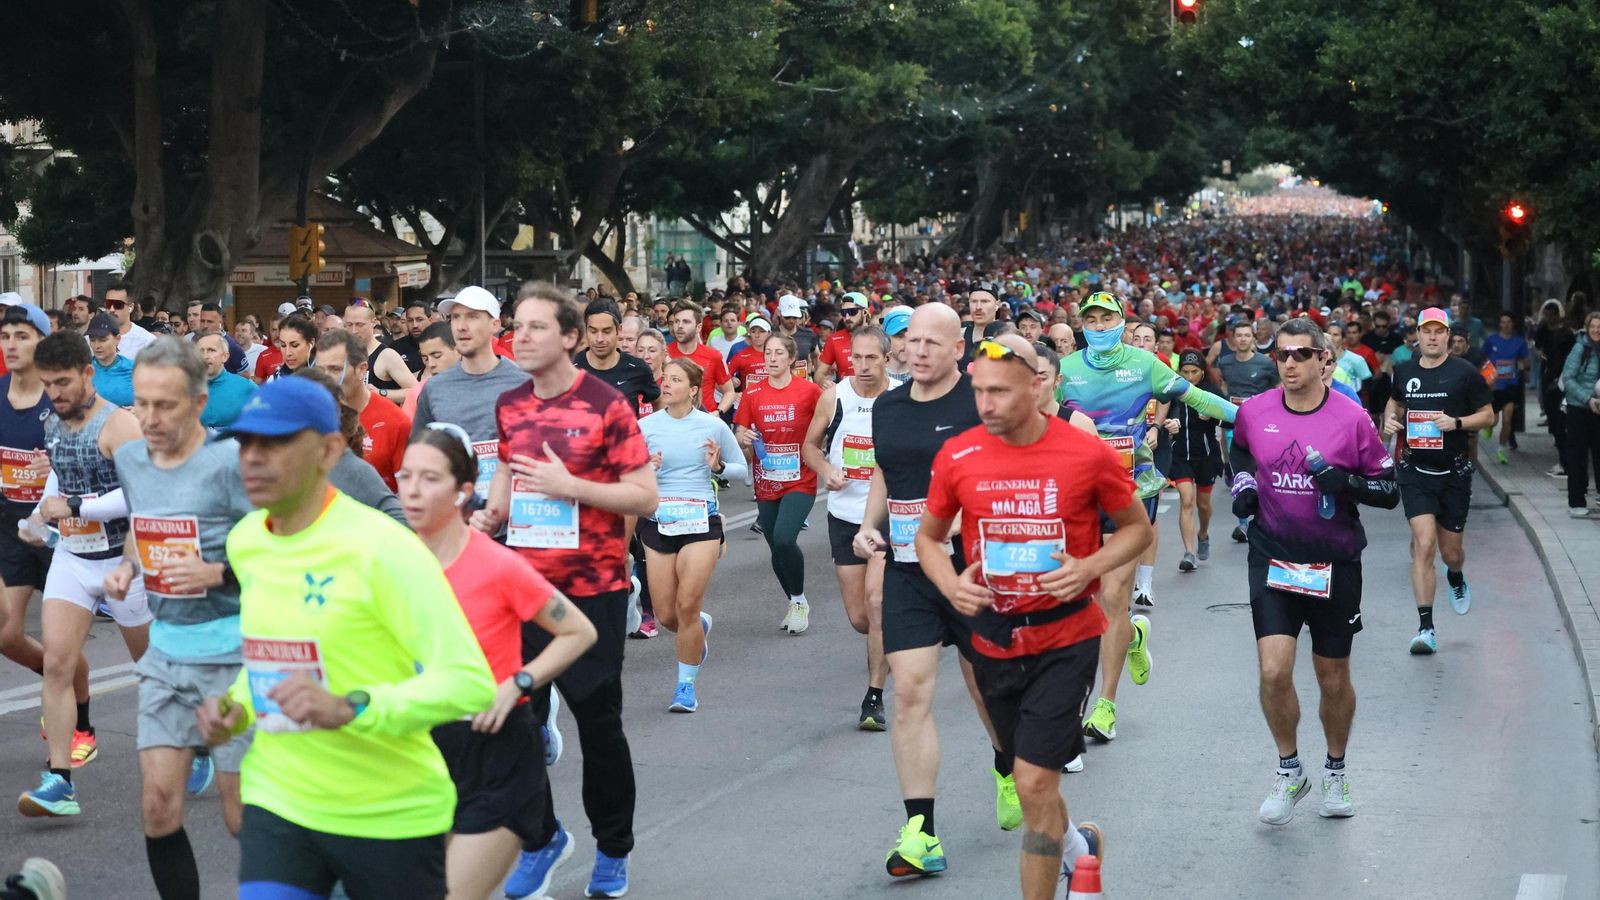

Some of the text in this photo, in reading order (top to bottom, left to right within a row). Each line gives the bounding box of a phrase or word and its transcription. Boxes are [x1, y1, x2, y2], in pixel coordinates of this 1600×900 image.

[854, 437, 874, 445] GENE
[12, 468, 38, 480] 2259
[1271, 471, 1314, 489] DARK
[991, 479, 1040, 490] GENERALI
[521, 502, 561, 517] 16796
[991, 498, 1042, 516] MÁLAGA
[145, 520, 192, 534] GENERALI
[1002, 523, 1058, 535] GENERALI
[1007, 547, 1038, 562] 725
